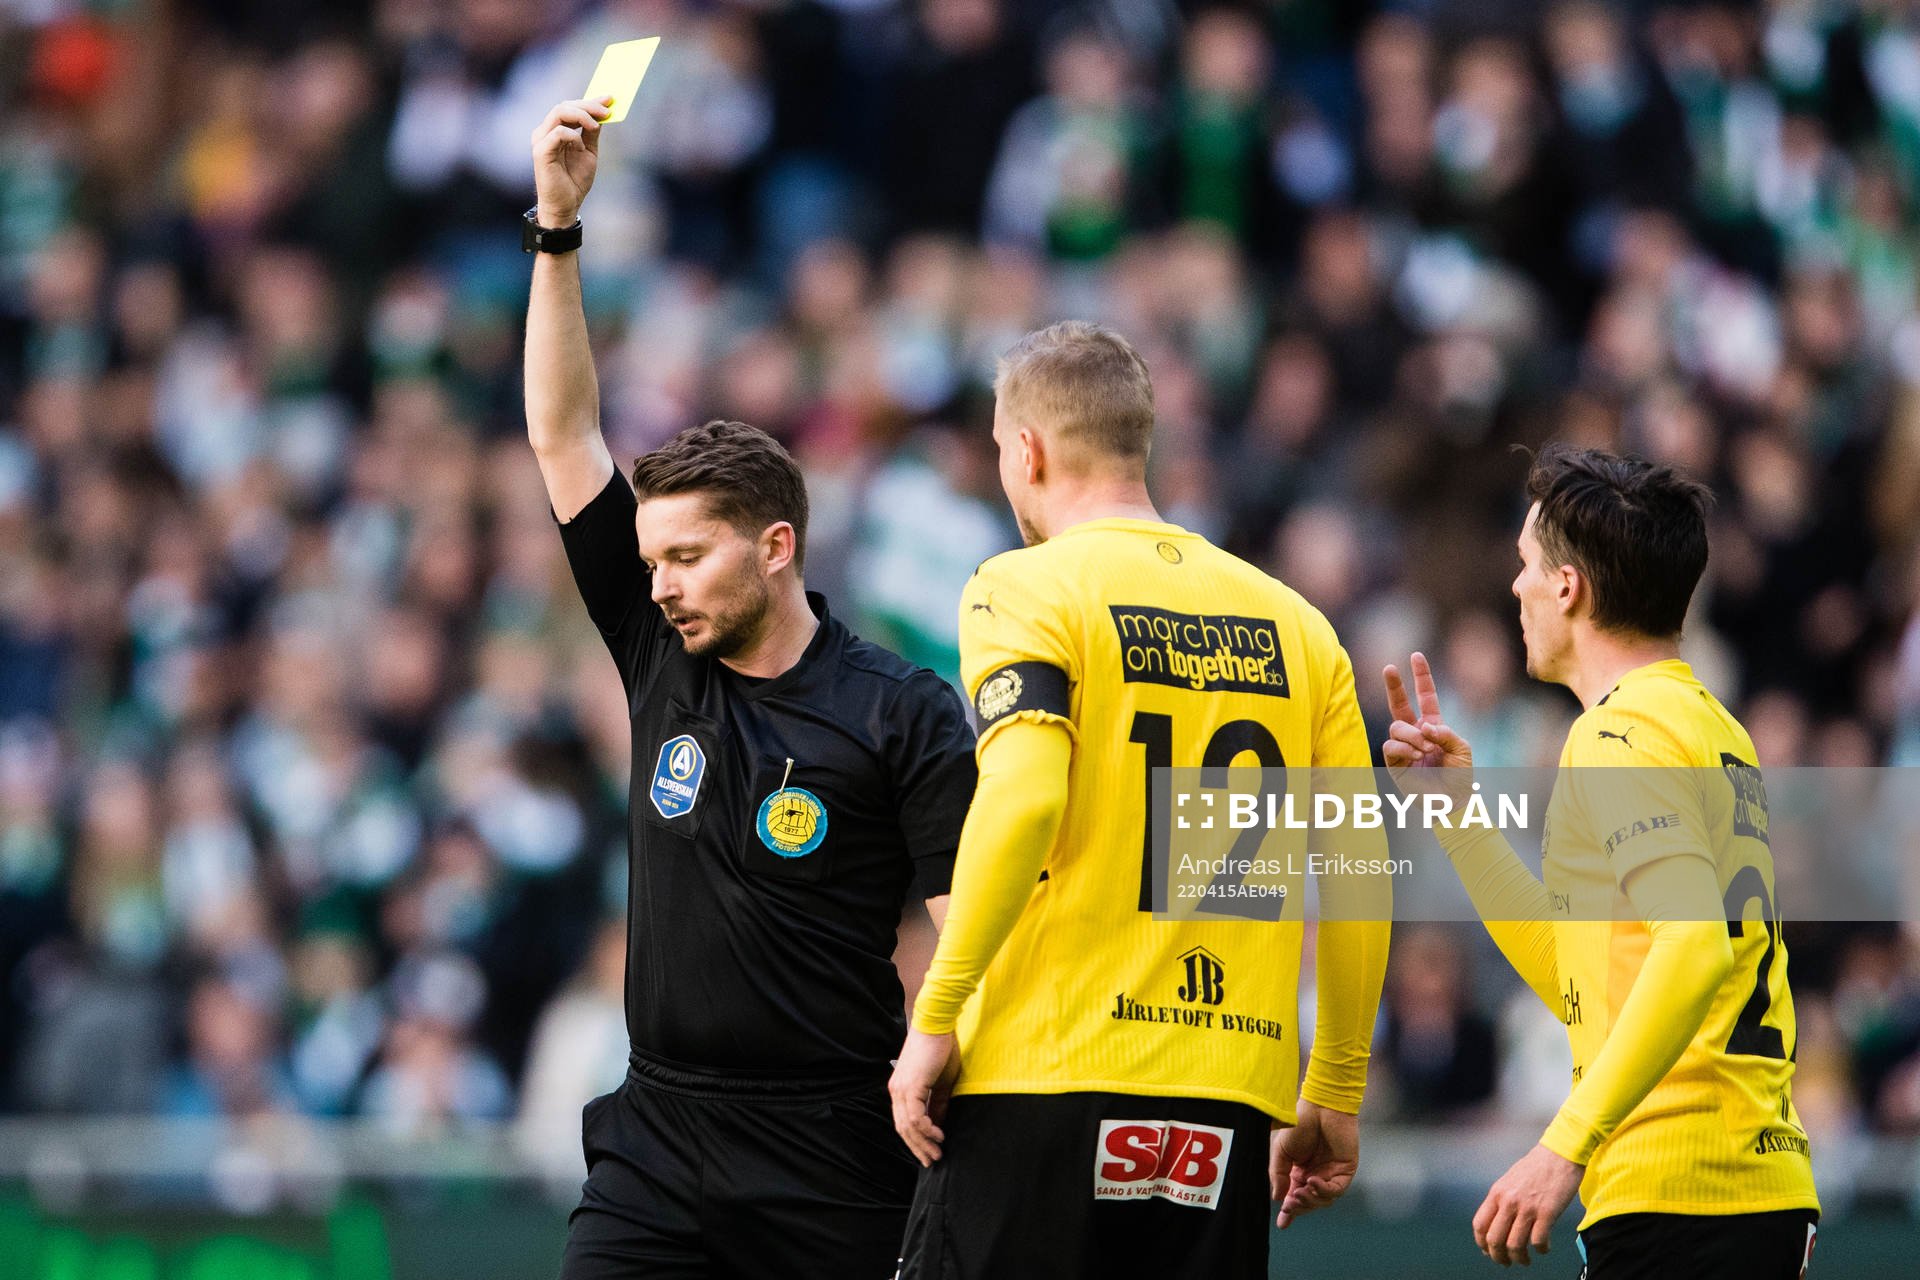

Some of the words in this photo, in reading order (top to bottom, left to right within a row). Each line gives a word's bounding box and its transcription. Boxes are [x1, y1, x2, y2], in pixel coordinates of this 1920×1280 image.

[1118, 613, 1276, 661] marching
[1126, 642, 1163, 672] on
[1166, 645, 1269, 690] together
[656, 776, 694, 799] ALLSVENSKAN
[784, 826, 799, 835] 1977
[1128, 710, 1288, 923] 12
[1605, 814, 1669, 855] FEAB
[1177, 952, 1225, 1006] JB
[1111, 991, 1214, 1029] JÄRLETOFT
[1221, 1012, 1283, 1041] BYGGER
[1096, 1186, 1125, 1196] SAND
[1126, 1186, 1133, 1196] &
[1197, 1194, 1211, 1203] AB
